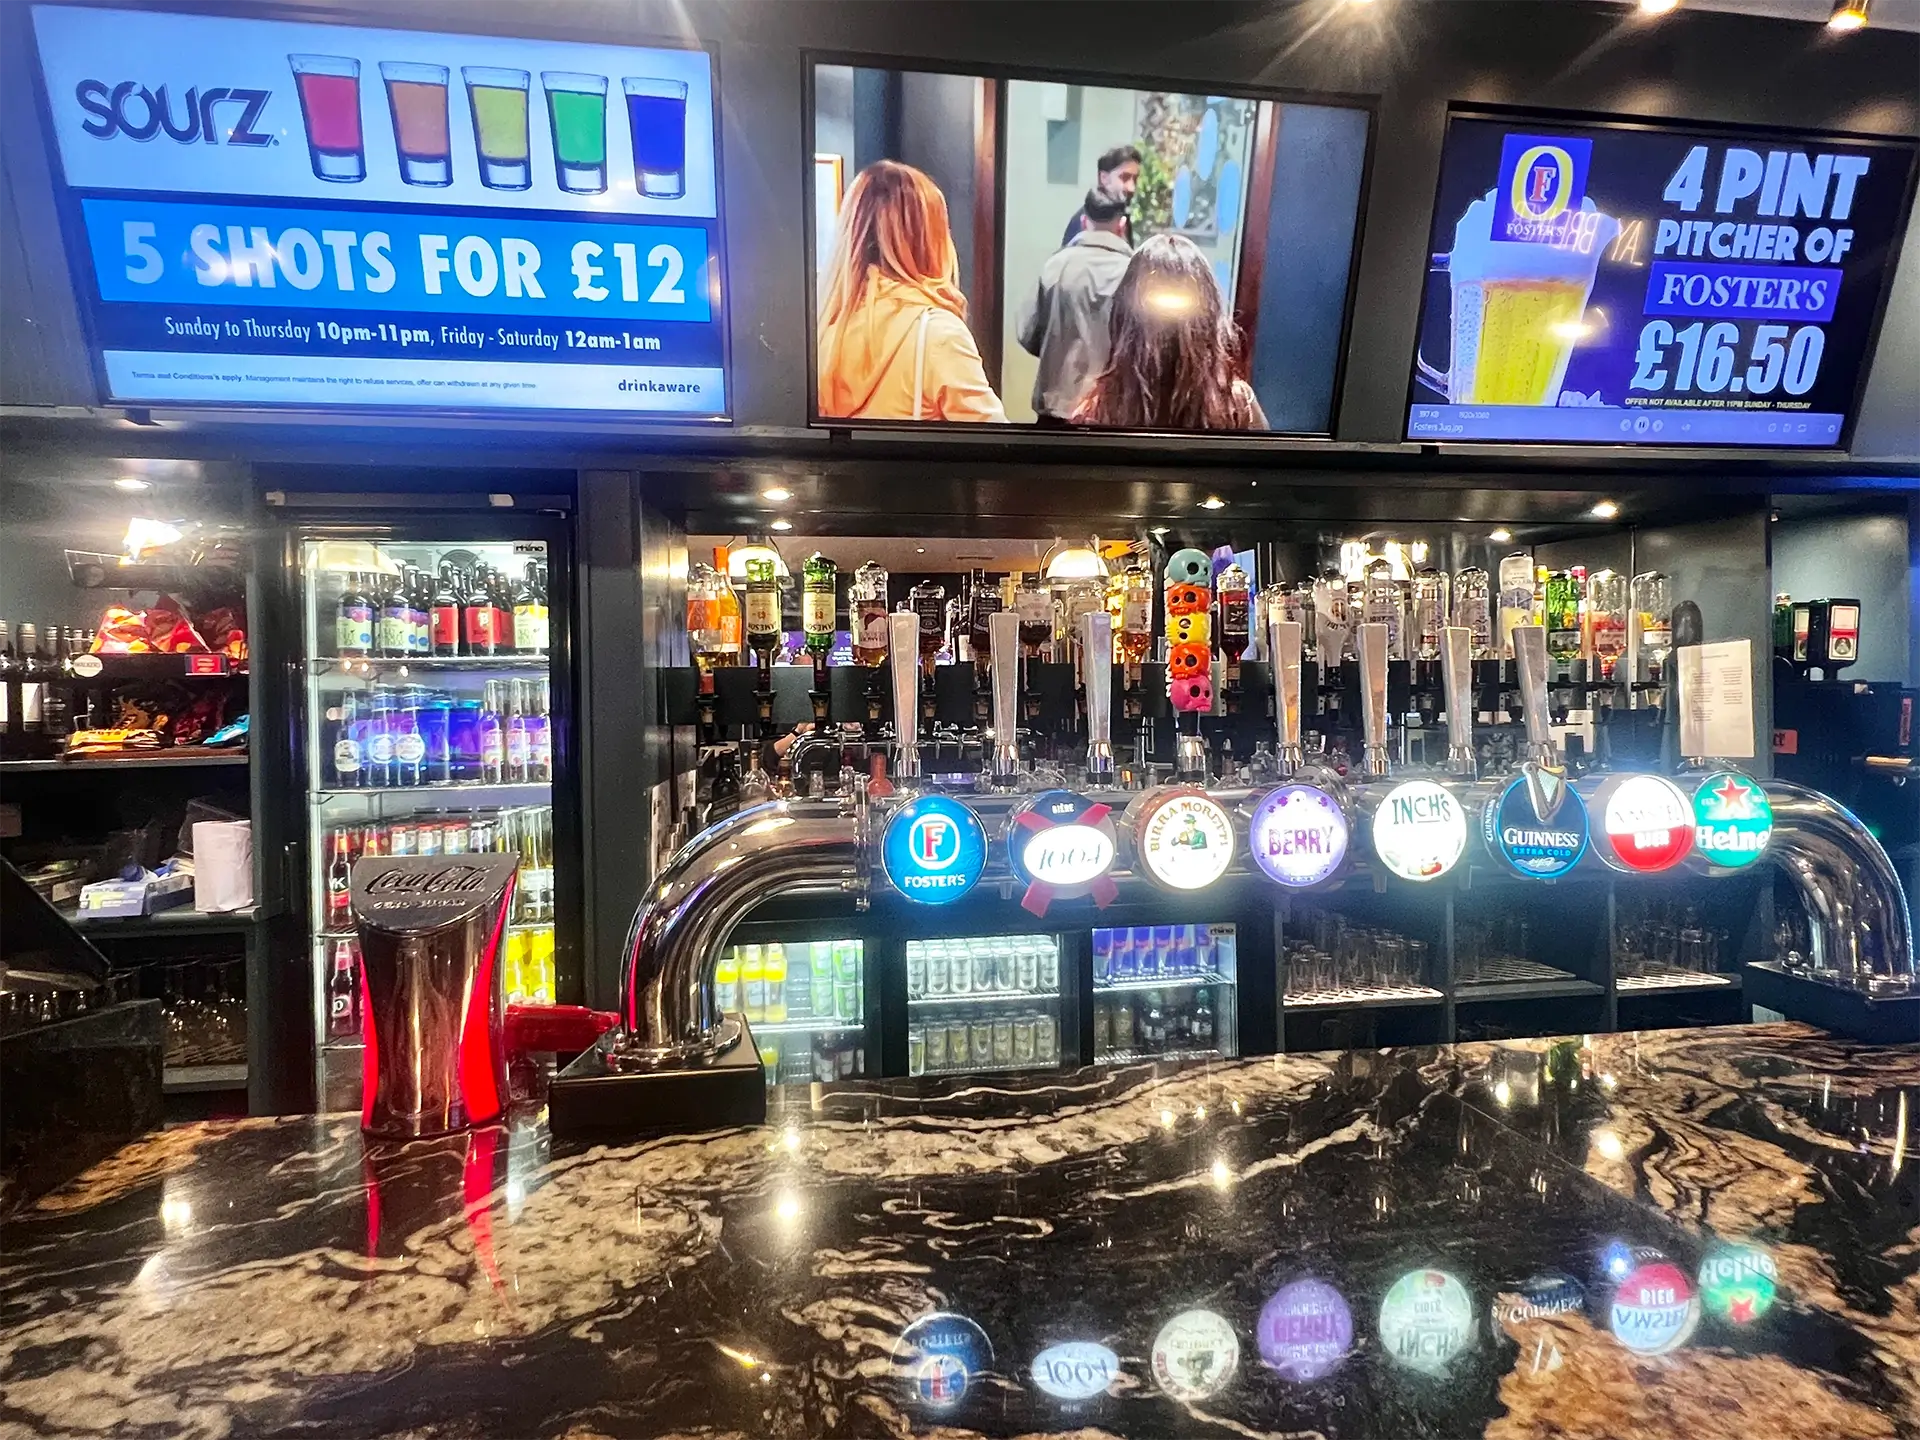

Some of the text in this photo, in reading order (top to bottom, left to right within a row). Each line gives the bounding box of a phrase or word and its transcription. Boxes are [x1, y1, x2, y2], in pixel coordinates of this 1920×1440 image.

[1663, 146, 1871, 220] 4 PINT
[1654, 219, 1854, 263] PITCHER OF
[122, 221, 686, 304] 5 SHOTS FOR £12
[1658, 273, 1828, 311] FOSTER'S
[165, 316, 220, 340] Sunday
[225, 321, 240, 337] to
[243, 319, 311, 343] Thursday
[316, 322, 435, 347] 10pm-11pm,
[441, 326, 485, 348] Friday
[498, 328, 559, 350] Saturday
[565, 330, 661, 350] 12am-1am
[1629, 320, 1825, 395] £16.50
[132, 371, 156, 379] Terms
[245, 374, 291, 383] Management
[338, 377, 354, 386] right
[363, 377, 385, 385] refuse
[618, 379, 700, 393] drinkaware
[1664, 399, 1702, 407] AVAILABLE
[1413, 422, 1438, 432] Fosters
[515, 543, 544, 553] rhino
[1392, 793, 1452, 824] INCH'S
[923, 825, 943, 858] F
[1151, 806, 1174, 852] BIRRA
[1268, 826, 1334, 856] BERRY
[1503, 827, 1580, 848] GUINNESS
[1513, 847, 1572, 857] EXTRA COLD
[904, 873, 966, 889] FOSTER'S
